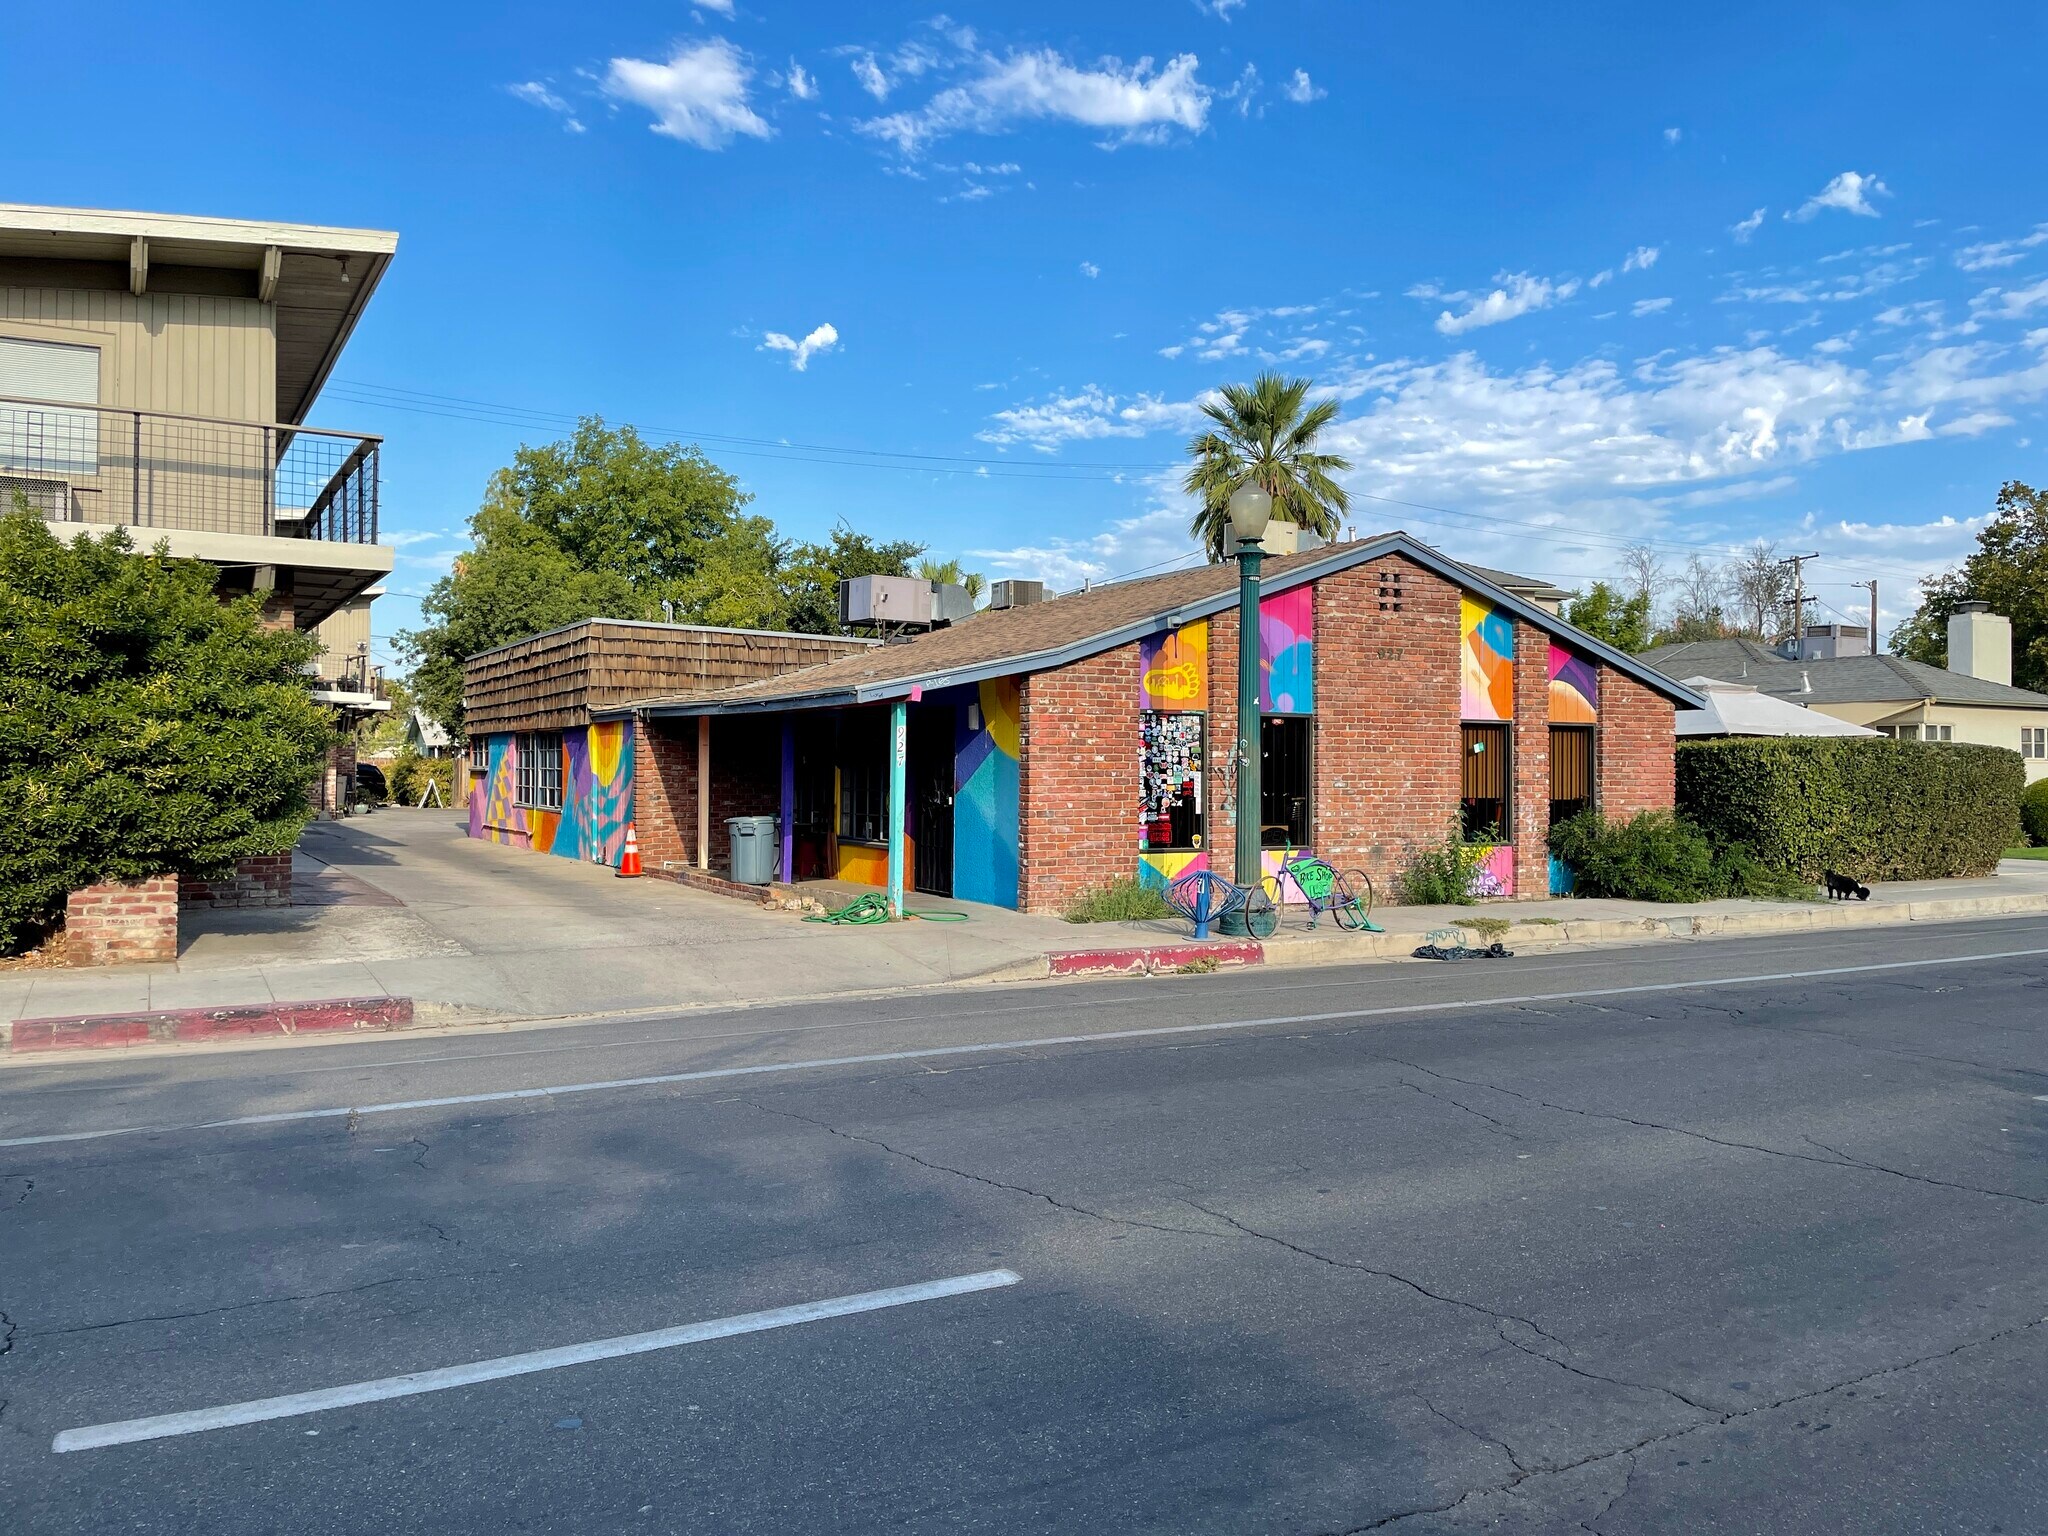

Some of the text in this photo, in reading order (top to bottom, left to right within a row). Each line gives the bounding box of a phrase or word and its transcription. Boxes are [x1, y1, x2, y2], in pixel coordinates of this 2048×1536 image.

[1378, 647, 1403, 661] 927
[896, 726, 905, 766] 927
[1316, 867, 1333, 881] SHOP
